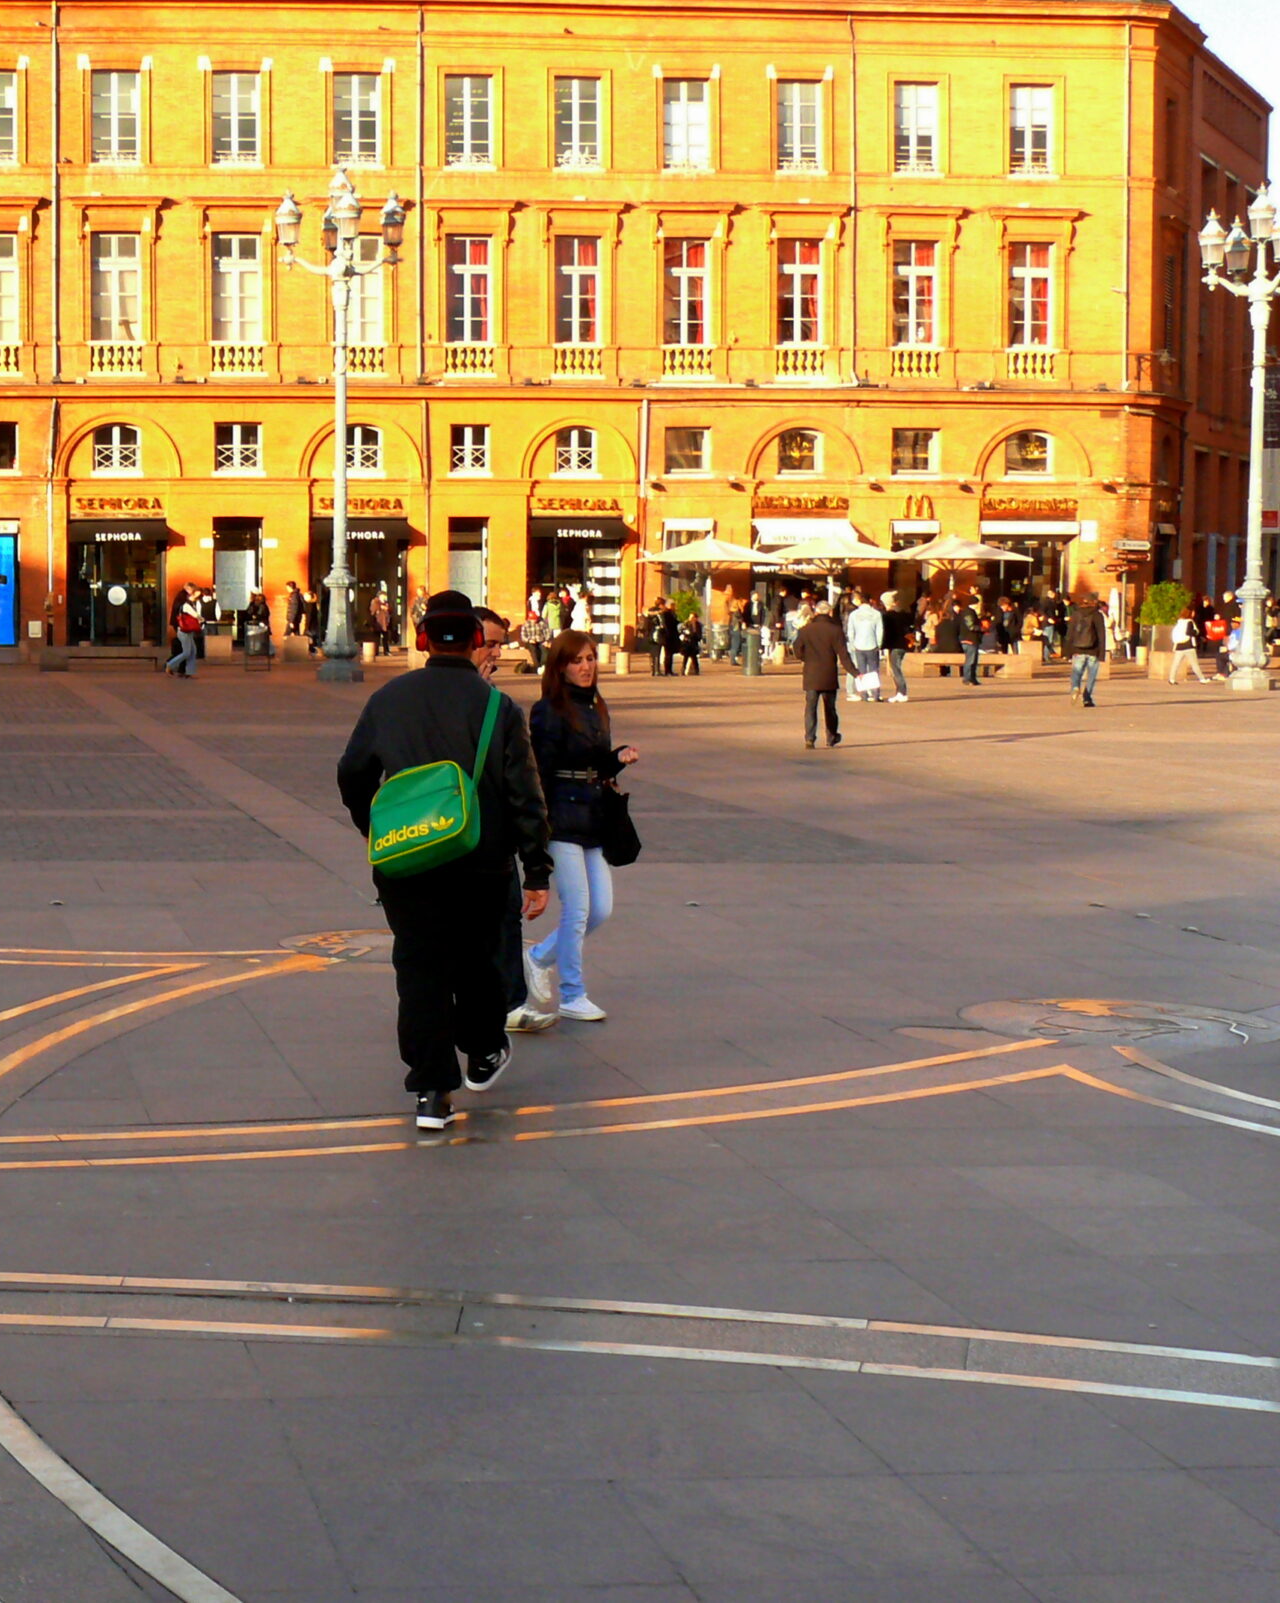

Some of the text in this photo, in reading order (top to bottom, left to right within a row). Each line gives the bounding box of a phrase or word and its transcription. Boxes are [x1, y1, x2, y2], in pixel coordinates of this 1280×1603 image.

[76, 497, 163, 511] SEPHORA
[537, 497, 621, 511] SEPHORA
[95, 532, 142, 542] SEPHORA
[346, 531, 386, 540] EPHORA
[557, 529, 603, 538] SEPHORA
[374, 822, 430, 851] adidas
